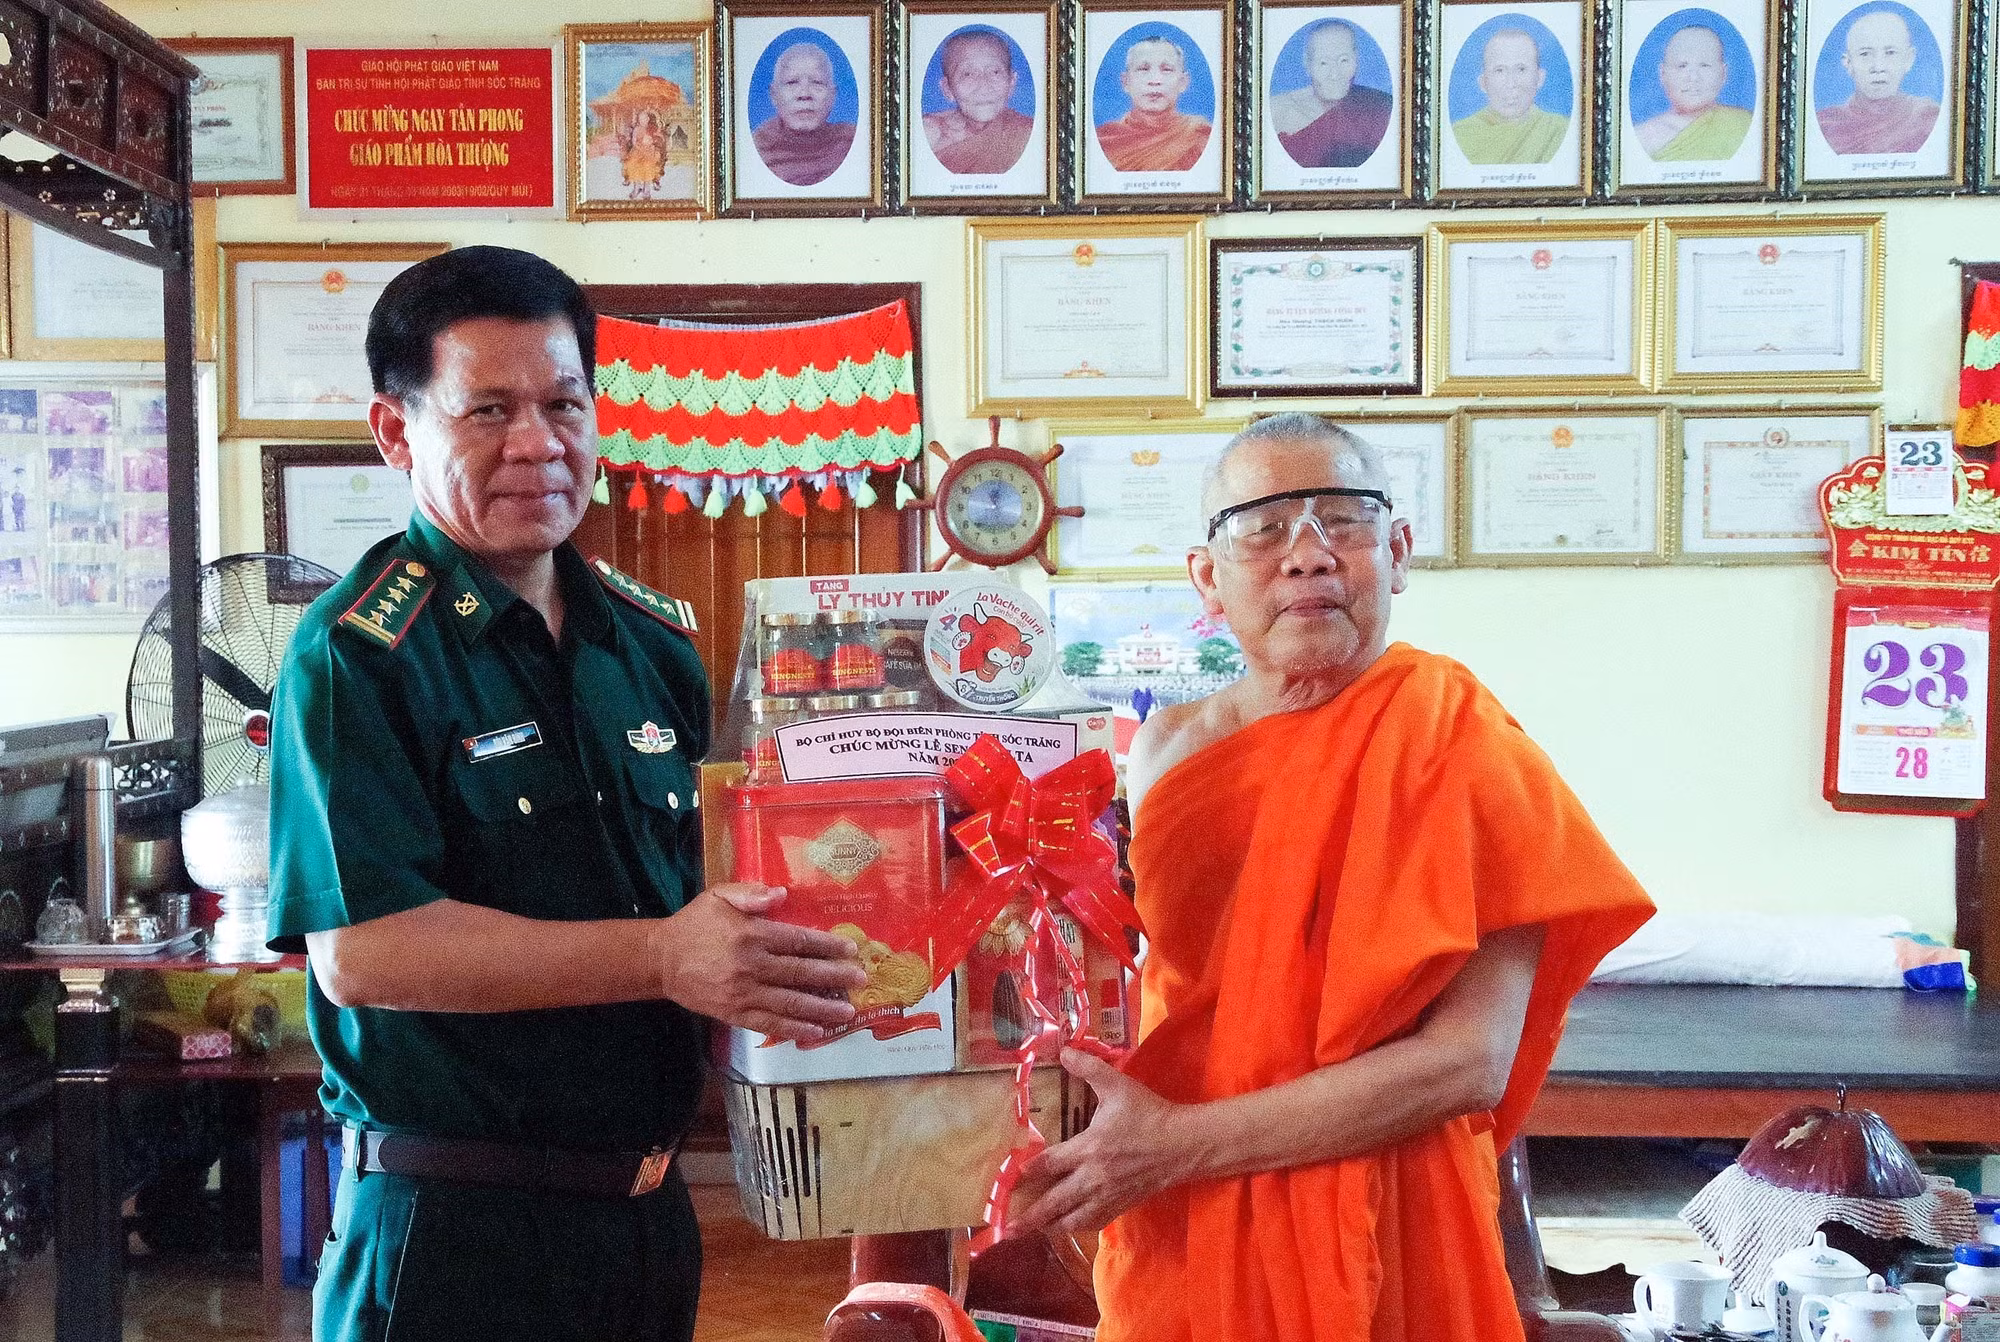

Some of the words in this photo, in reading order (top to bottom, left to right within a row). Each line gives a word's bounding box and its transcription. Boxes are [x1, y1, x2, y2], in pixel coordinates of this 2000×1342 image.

[456, 57, 477, 74] VIỆT
[478, 59, 499, 73] NAM
[315, 77, 337, 92] BAN
[371, 103, 409, 132] MỪNG
[478, 106, 524, 133] PHONG
[349, 138, 382, 167] GIÁO
[384, 133, 423, 167] PHẨM
[426, 137, 454, 166] HÒA
[456, 137, 510, 172] THƯỢNG
[1899, 441, 1943, 466] 23
[1871, 545, 1921, 560] KIM
[1926, 544, 1967, 563] TÍN
[818, 594, 841, 610] LY
[847, 586, 905, 609] THỦY
[911, 590, 949, 607] TIN
[977, 592, 989, 602] La
[989, 593, 1021, 614] Vache
[1862, 641, 1969, 708] 23
[796, 736, 813, 747] BỘ
[814, 732, 836, 744] CHỈ
[839, 730, 863, 740] HUY
[866, 728, 881, 738] BỘ
[884, 728, 905, 738] ĐỘI
[907, 726, 933, 735] BIÊN
[935, 728, 971, 741] PHÒNG
[1002, 733, 1023, 745] SÓC
[1024, 736, 1061, 749] TRĂNG
[829, 740, 872, 755] CHÚC
[876, 738, 921, 752] MỪNG
[908, 751, 939, 766] NĂM
[1896, 747, 1929, 779] 28
